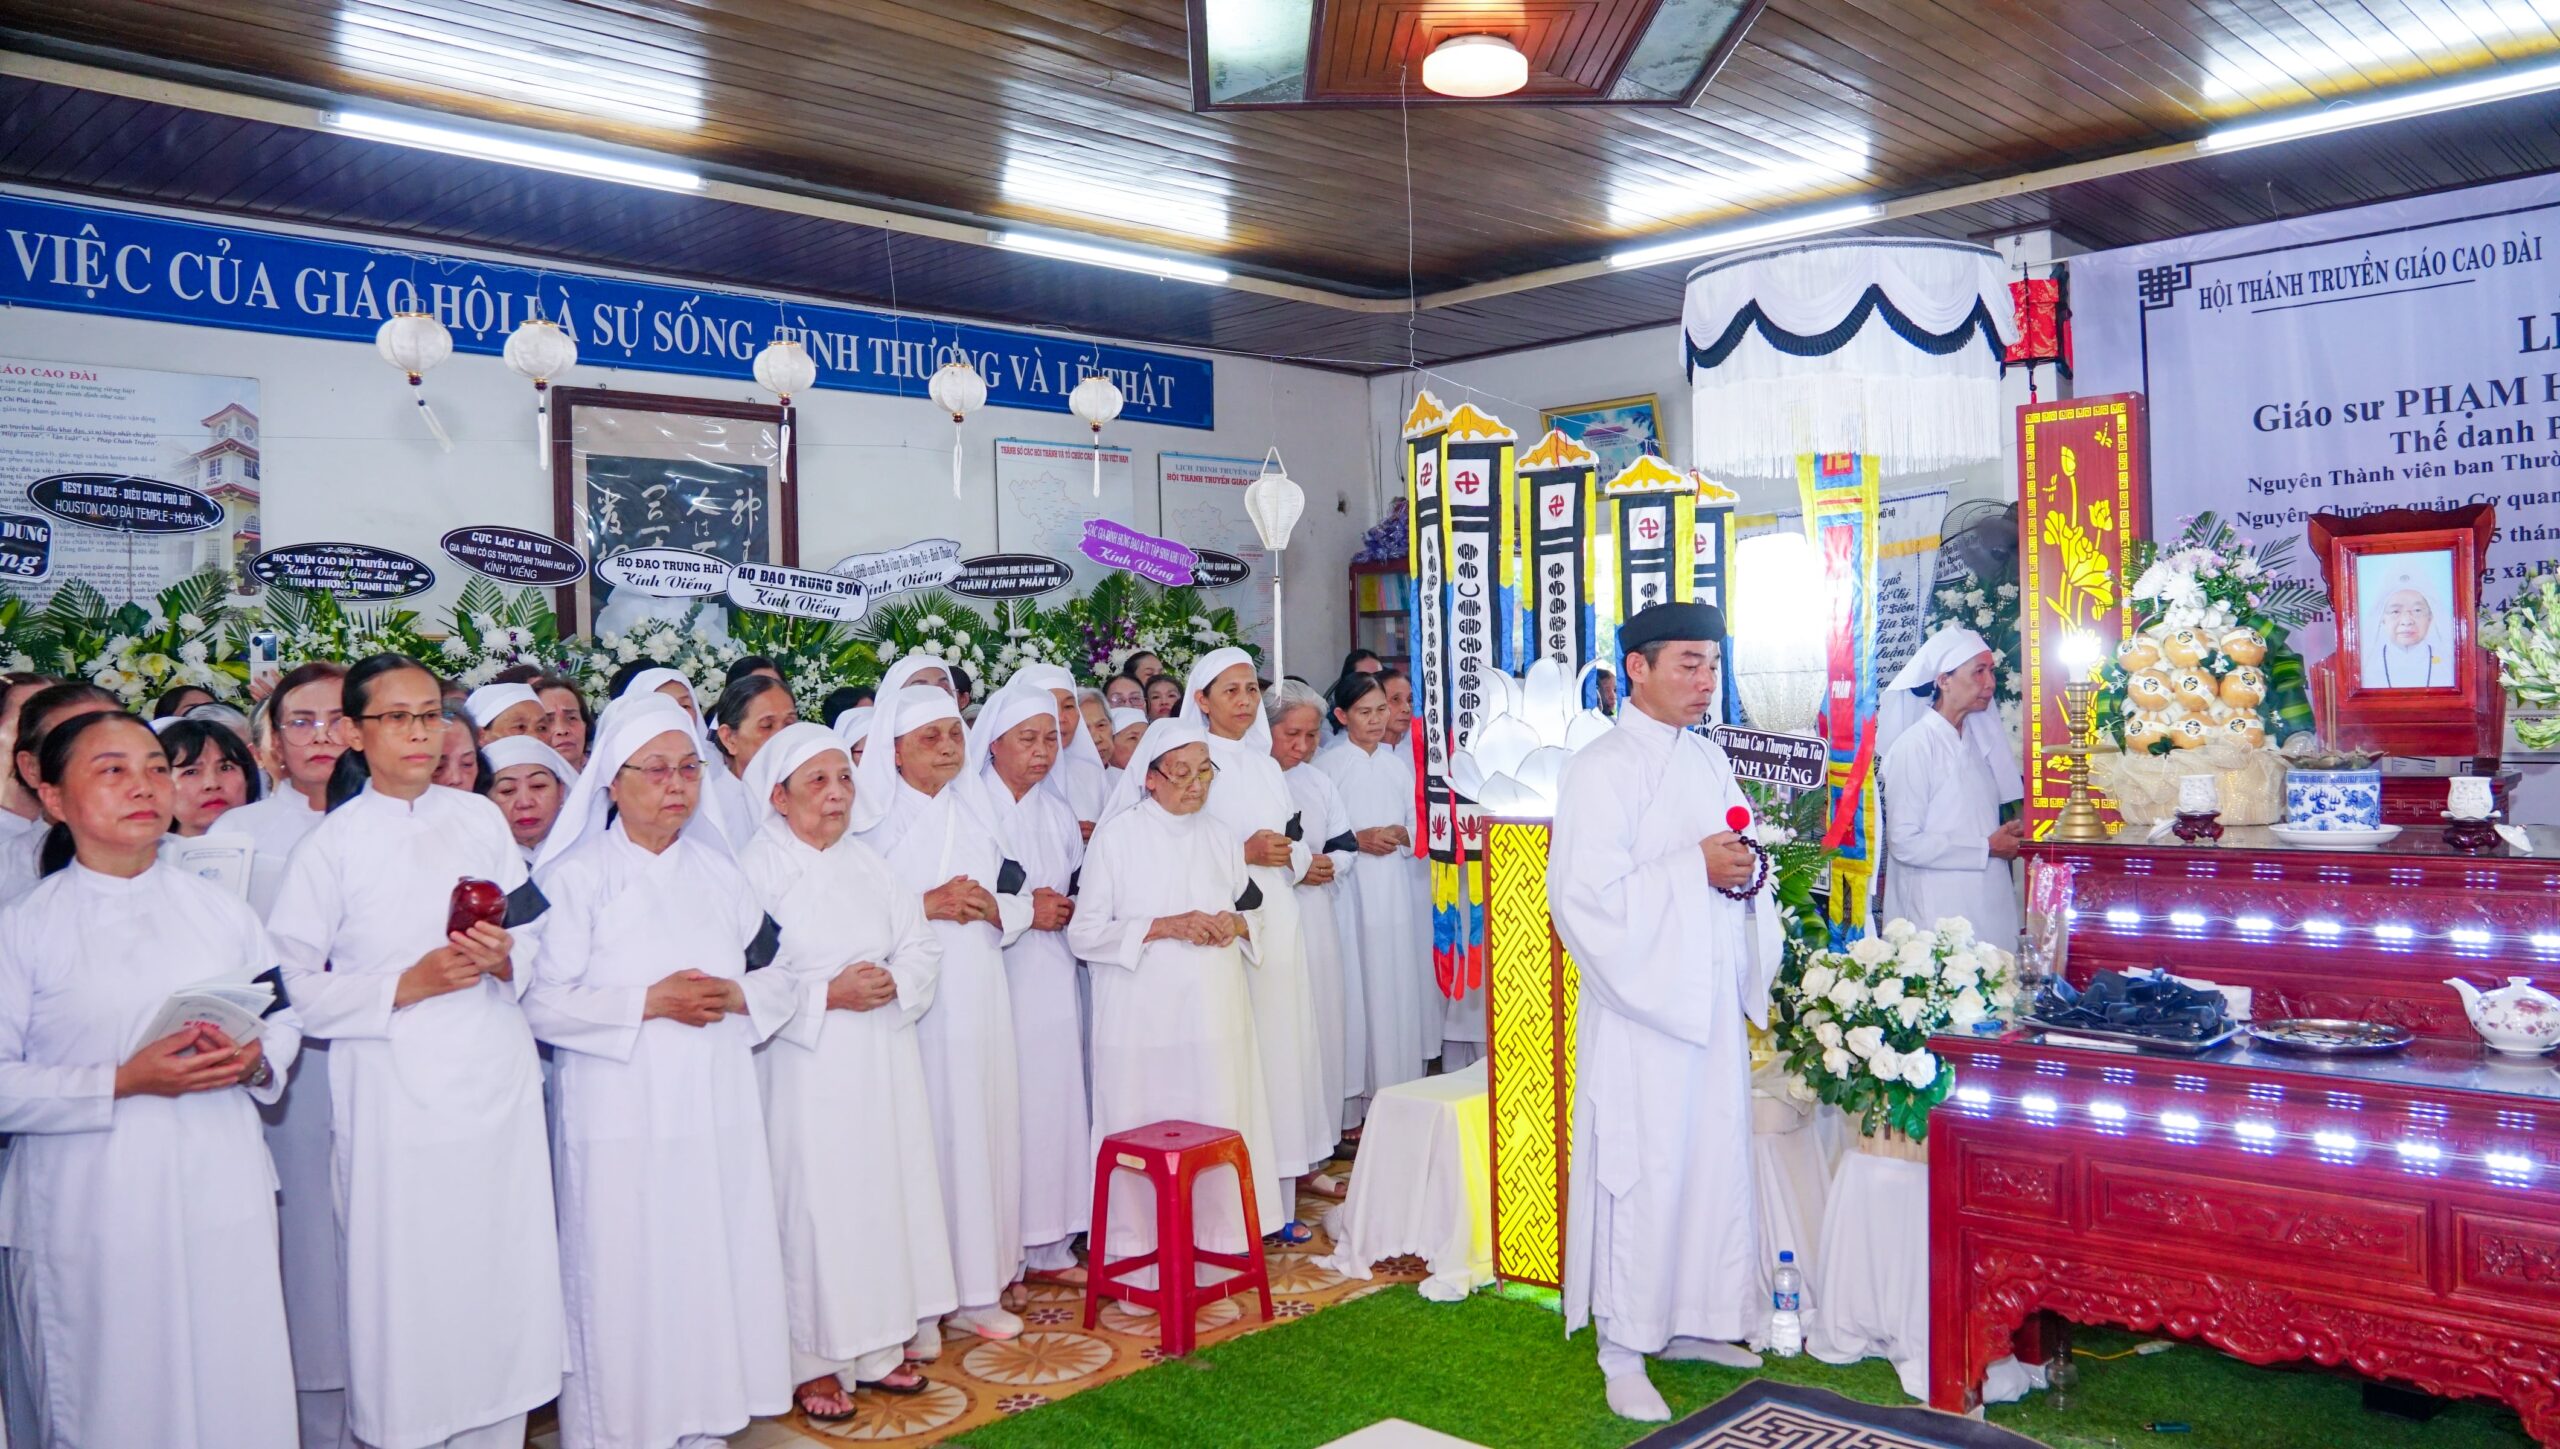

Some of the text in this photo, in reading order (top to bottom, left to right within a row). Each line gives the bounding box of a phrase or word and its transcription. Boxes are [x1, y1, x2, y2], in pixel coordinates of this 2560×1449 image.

[2199, 231, 2543, 313] HỘI THÁNH TRUYỀN GIÁO CAO ĐÀI
[6, 223, 152, 299] VIỆC
[168, 237, 280, 310] CỦA
[294, 260, 418, 320] GIÁO
[430, 275, 514, 341] HỘI
[592, 300, 645, 358] SỰ
[653, 295, 756, 361] SỐNG
[1009, 347, 1050, 393] VÀ
[0, 363, 97, 381] ÁO CAO ĐÀI
[2253, 376, 2529, 432] Giáo sư PHẠM
[2389, 419, 2535, 454] Thế danh
[2247, 472, 2322, 496] Nguyên
[2328, 466, 2395, 486] Thành
[2402, 462, 2446, 479] viên
[2453, 459, 2494, 475] ban
[61, 482, 83, 494] REST
[83, 484, 92, 495] IN
[93, 485, 117, 498] PEACE
[142, 490, 162, 503] CUNG
[55, 500, 98, 515] HOUSTON
[99, 505, 118, 518] CAO
[119, 503, 134, 519] ĐÀI
[135, 508, 168, 523] TEMPLE
[174, 512, 194, 526] HOA
[2236, 507, 2309, 530] Nguyên
[449, 542, 460, 553] GIA
[534, 557, 554, 569] THANH
[553, 559, 566, 570] HOA
[471, 532, 552, 555] CỰC LẠC AN VUI
[1457, 543, 1479, 561] NAM
[272, 553, 293, 563] HỌC
[294, 553, 316, 565] VIỆN
[317, 555, 337, 565] CAO
[390, 559, 414, 571] GIÁO
[483, 560, 538, 579] KÍNH VIẾNG
[617, 557, 633, 571] HỌ
[636, 558, 660, 572] ĐẠO
[662, 561, 701, 573] TRUNG
[1096, 546, 1176, 582] Kính Viếng
[352, 580, 406, 593] THANH BÌNH
[664, 575, 713, 593] Viếng
[737, 566, 756, 584] HỌ
[759, 569, 786, 587] ĐẠO
[836, 581, 862, 596] SƠN
[869, 570, 943, 596] ính Viếng
[991, 576, 1017, 589] KÍNH
[1640, 582, 1658, 598] NAM
[750, 588, 841, 618] Kính Viếng
[1728, 732, 1750, 750] Thánh
[1750, 735, 1765, 752] Cao
[1765, 737, 1792, 760] Thượng
[1809, 743, 1824, 761] Tòa
[1728, 755, 1813, 784] ÍNH VIẾNG
